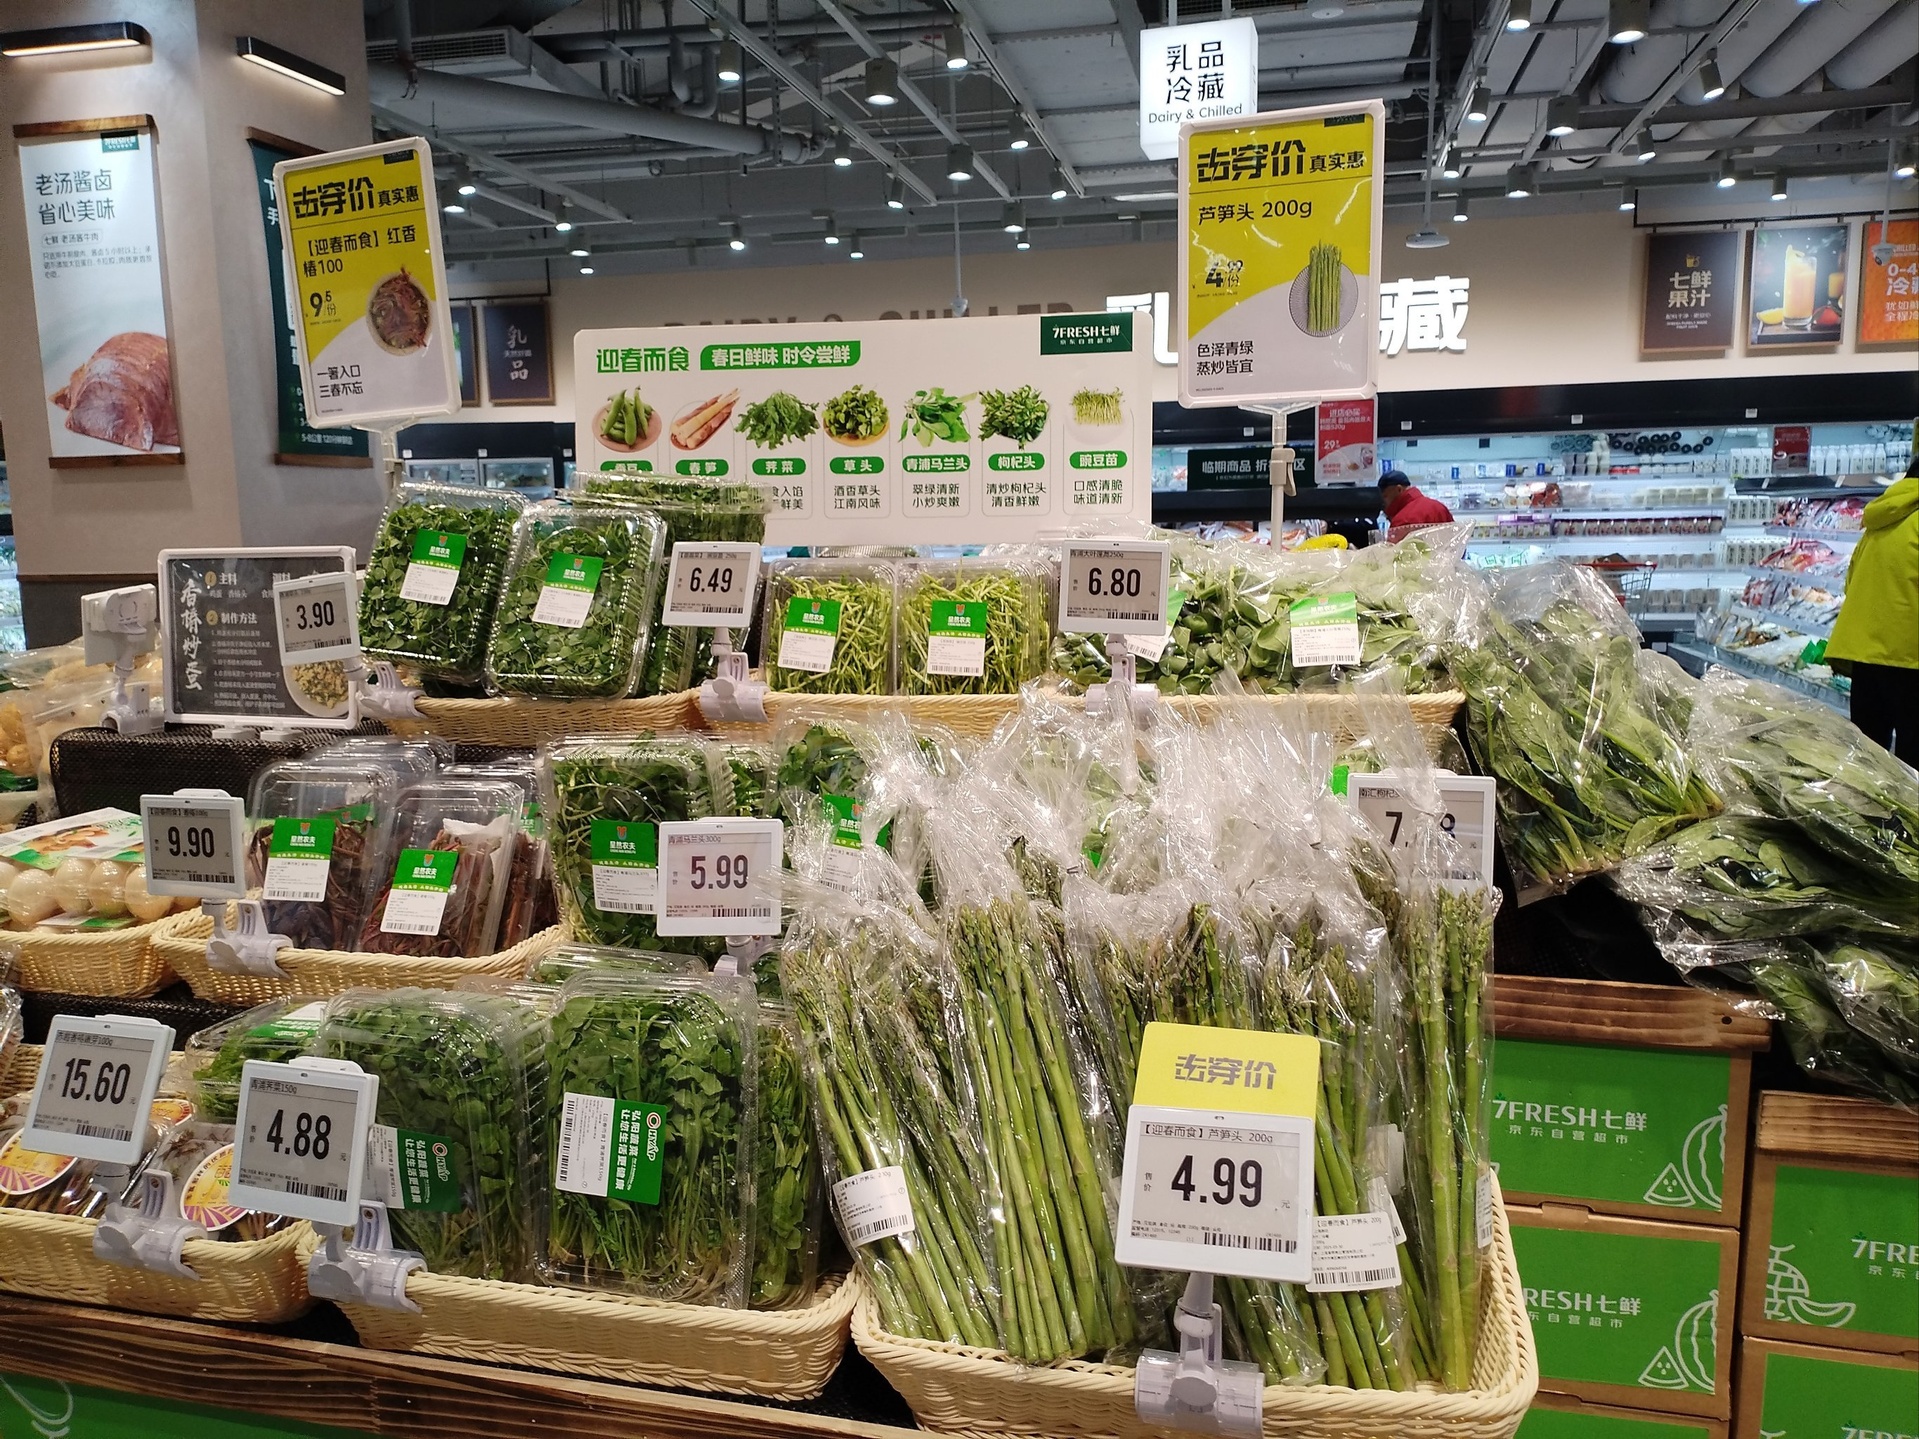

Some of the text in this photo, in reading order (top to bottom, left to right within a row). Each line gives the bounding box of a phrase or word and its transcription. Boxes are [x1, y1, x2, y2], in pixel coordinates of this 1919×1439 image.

[1166, 40, 1224, 72] 乳品
[1166, 73, 1224, 104] 冷藏
[1149, 103, 1242, 124] Dairy & Chilled
[1310, 151, 1365, 173] 真实惠
[36, 168, 112, 196] 老汤酱卤
[378, 185, 419, 208] 真实惠
[39, 197, 116, 225] 省心美味
[1199, 200, 1313, 225] 芦笋头 200g
[1669, 270, 1712, 289] 七鲜
[1668, 289, 1711, 308] 果汁
[1197, 341, 1254, 357] 色泽青绿
[596, 344, 851, 375] 迎春而食 春日鲜味 时令尝鲜
[1197, 359, 1253, 376] 蒸炒皆宜
[319, 382, 364, 398] 三春不忘
[688, 462, 717, 474] 春笋
[765, 460, 794, 474] 荠菜
[844, 460, 873, 473] 草头
[906, 457, 968, 472] 青浦马兰头
[998, 455, 1036, 470] 枸杞头
[1079, 454, 1119, 468] 豌豆苗
[1202, 460, 1251, 473] 临期商品
[834, 485, 881, 497] 酒香草头
[912, 483, 960, 496] 翠绿清新
[986, 482, 1046, 495] 清炒枸杞头
[1074, 480, 1123, 492] 口感清脆
[834, 497, 881, 510] 江南风味
[912, 496, 960, 508] 小炒爽嫩
[991, 495, 1040, 508] 清香鲜嫩
[1073, 492, 1123, 505] 味道清新
[690, 567, 733, 593] 6.49
[1088, 567, 1141, 597] 6.80
[221, 612, 257, 624] 制作方法
[297, 601, 334, 630] 3.90
[168, 826, 215, 858] 9.90
[690, 855, 748, 889] 5.99
[61, 1058, 131, 1105] 15.60
[1492, 1100, 1648, 1132] 7FRESH七鲜
[267, 1109, 331, 1160] 4.88
[1249, 1132, 1273, 1144] 200g
[1509, 1124, 1629, 1144] 京东自营超市
[615, 1109, 630, 1190] 让您生活更健康
[1171, 1154, 1263, 1208] 4.99
[1281, 1200, 1290, 1209] 元
